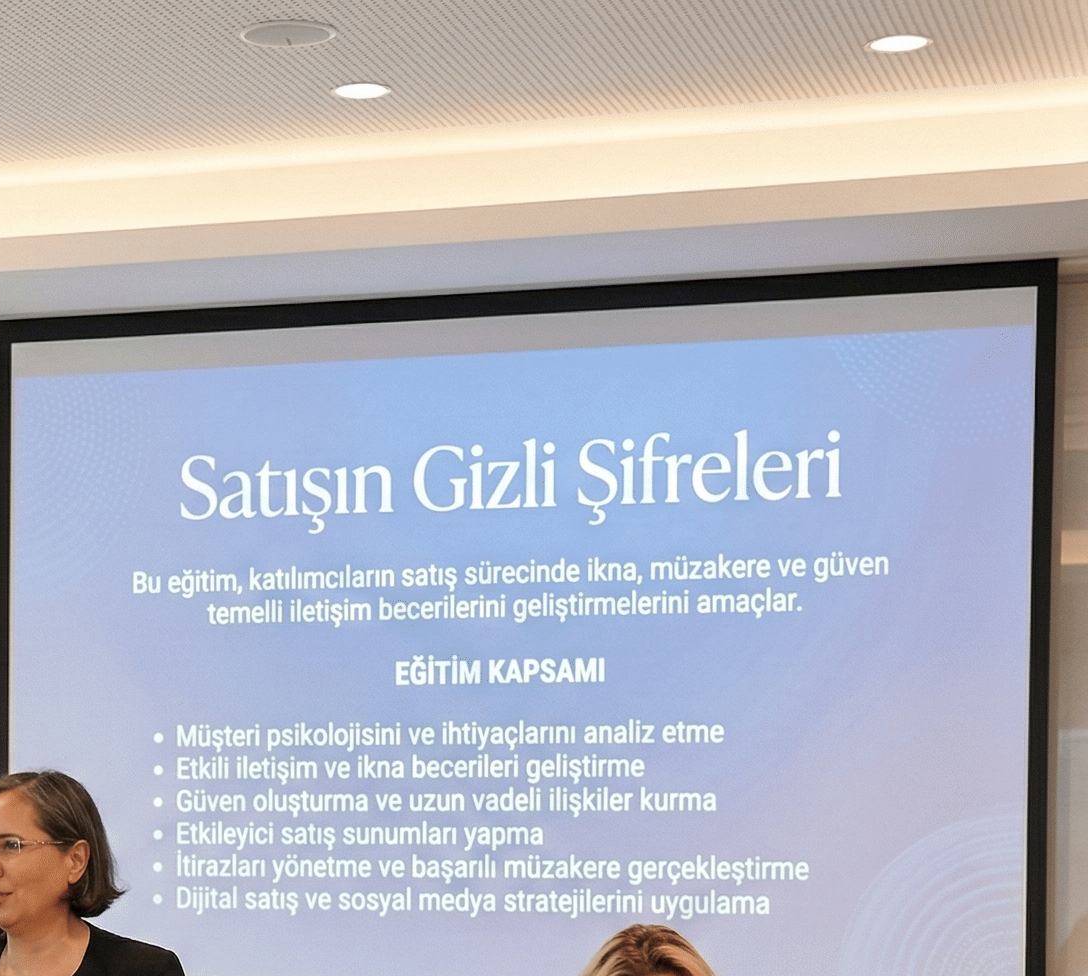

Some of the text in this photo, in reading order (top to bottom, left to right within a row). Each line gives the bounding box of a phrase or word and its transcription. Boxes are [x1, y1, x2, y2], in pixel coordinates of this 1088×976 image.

[180, 429, 842, 535] Satışın Gizli Şifreleri
[132, 551, 889, 599] Bu eğitim, katılımcıların satış sürecinde ikna, müzakere ve güven
[206, 586, 803, 628] temelli iletişim becerilerini geliştirmelerini amaçlar.
[395, 654, 606, 686] EĞİTİM KAPSAMI
[177, 718, 725, 753] Müşteri psikolojisini ve ihtiyaçlarını analiz etme
[177, 752, 646, 785] Etkili iletişim ve ikna becerileri geliştirme
[176, 786, 717, 818] Güven oluşturma ve uzun vadeli ilişkiler kurma
[177, 820, 544, 852] Etkileyici satış sunumları yapma
[177, 849, 809, 886] İtirazları yönetme ve başarılı müzakere gerçekleştirme
[177, 886, 770, 921] Dijital satış ve sosyal medya stratejilerini uygulama
